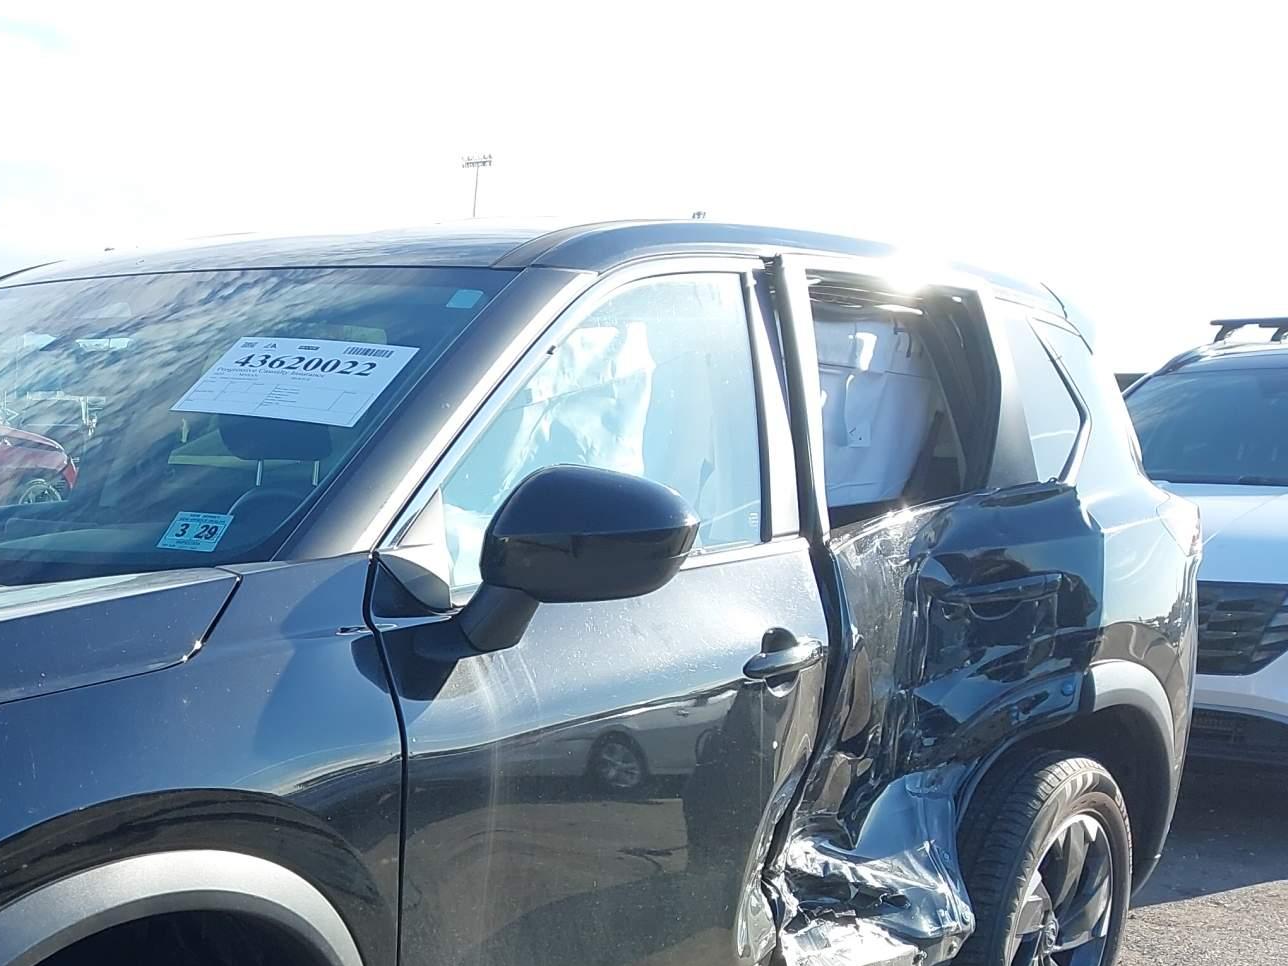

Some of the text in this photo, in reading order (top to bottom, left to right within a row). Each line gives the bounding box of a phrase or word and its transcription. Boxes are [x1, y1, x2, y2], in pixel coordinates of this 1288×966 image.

[235, 353, 377, 378] 43620022
[175, 523, 218, 539] 3 29
